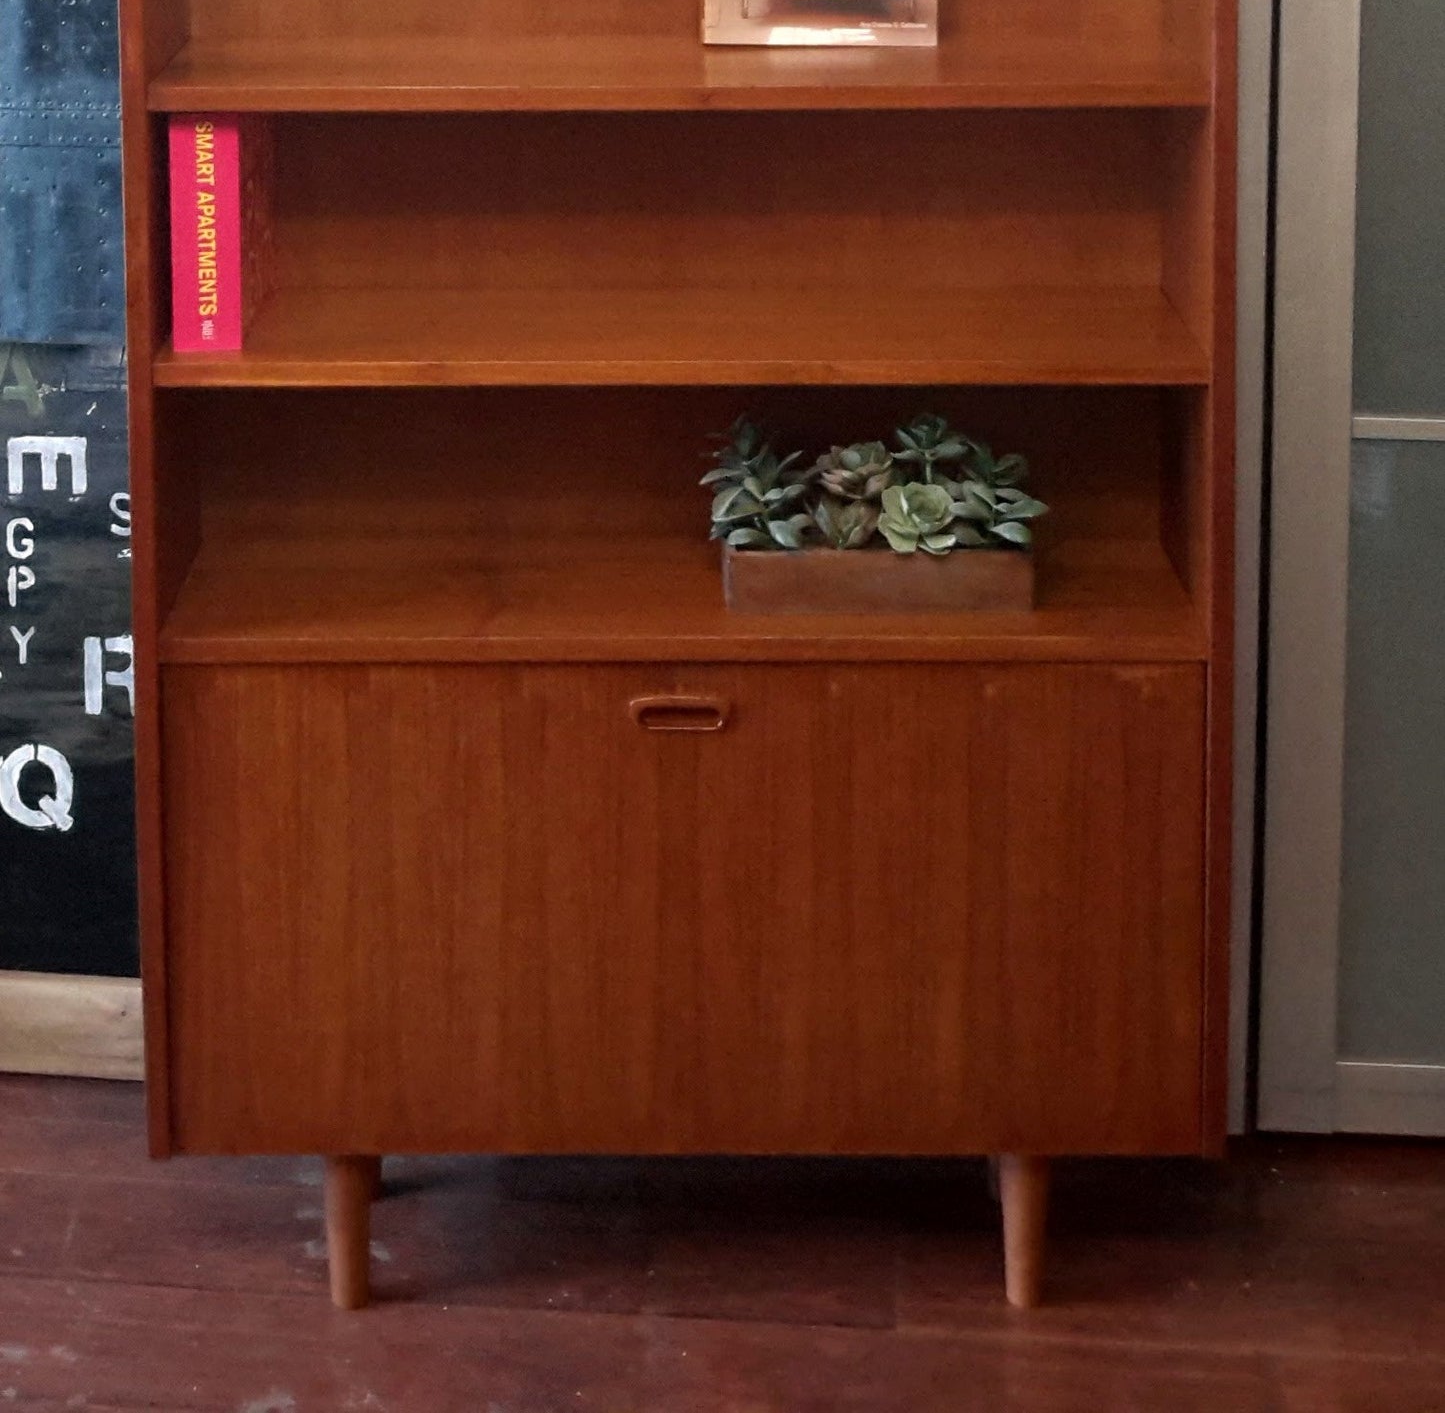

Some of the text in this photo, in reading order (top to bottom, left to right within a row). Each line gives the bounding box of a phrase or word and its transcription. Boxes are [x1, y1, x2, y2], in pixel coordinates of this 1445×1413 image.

[195, 121, 215, 186] SMART
[197, 191, 218, 317] APARTMENTS
[6, 517, 35, 560] G
[109, 492, 132, 536] S
[7, 565, 36, 608] P
[9, 625, 36, 664] Y
[83, 635, 135, 717] R
[0, 743, 74, 832] Q
